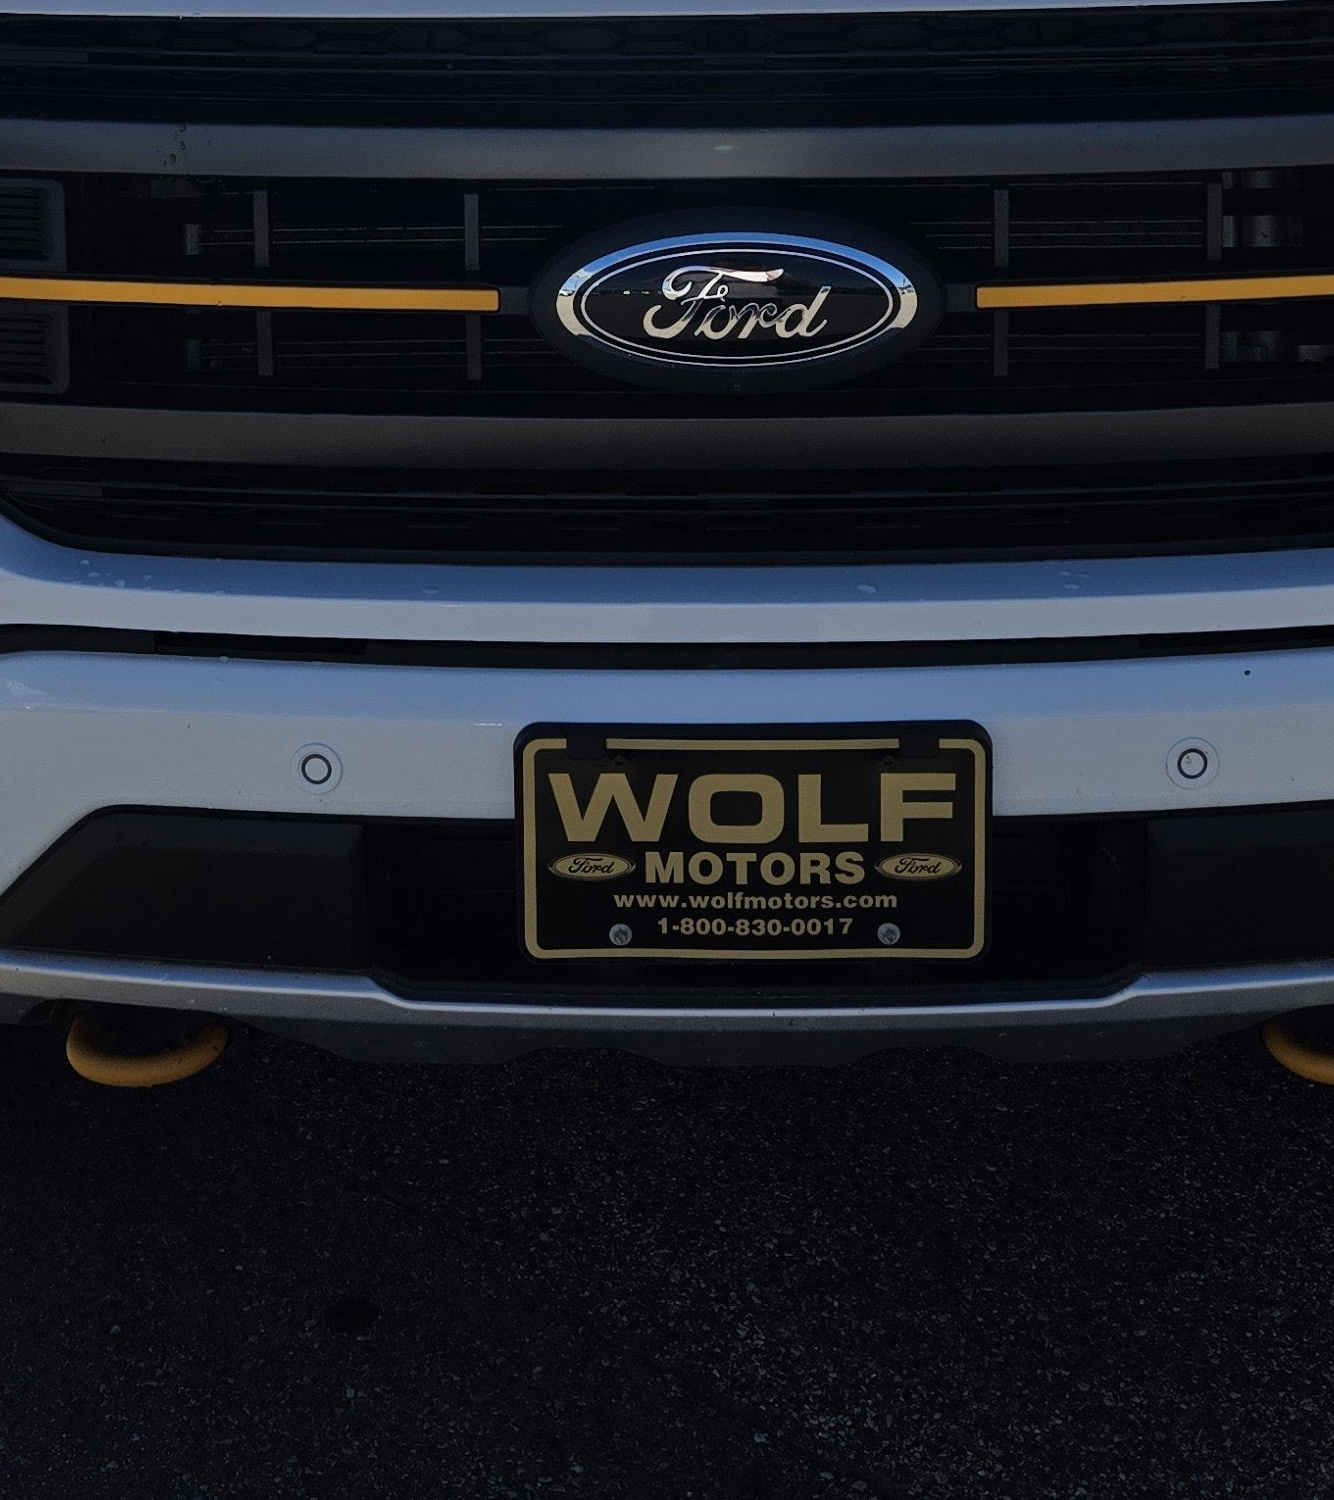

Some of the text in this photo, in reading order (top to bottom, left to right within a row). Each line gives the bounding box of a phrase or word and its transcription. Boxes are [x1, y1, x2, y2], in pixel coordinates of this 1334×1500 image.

[642, 265, 832, 340] Ford
[548, 772, 957, 845] WOLF
[567, 857, 615, 876] Ford
[645, 851, 866, 886] MOTORS
[893, 858, 942, 877] Ford
[613, 891, 898, 911] www.wolfmotors.com
[657, 917, 854, 938] 1-800-830-0017
